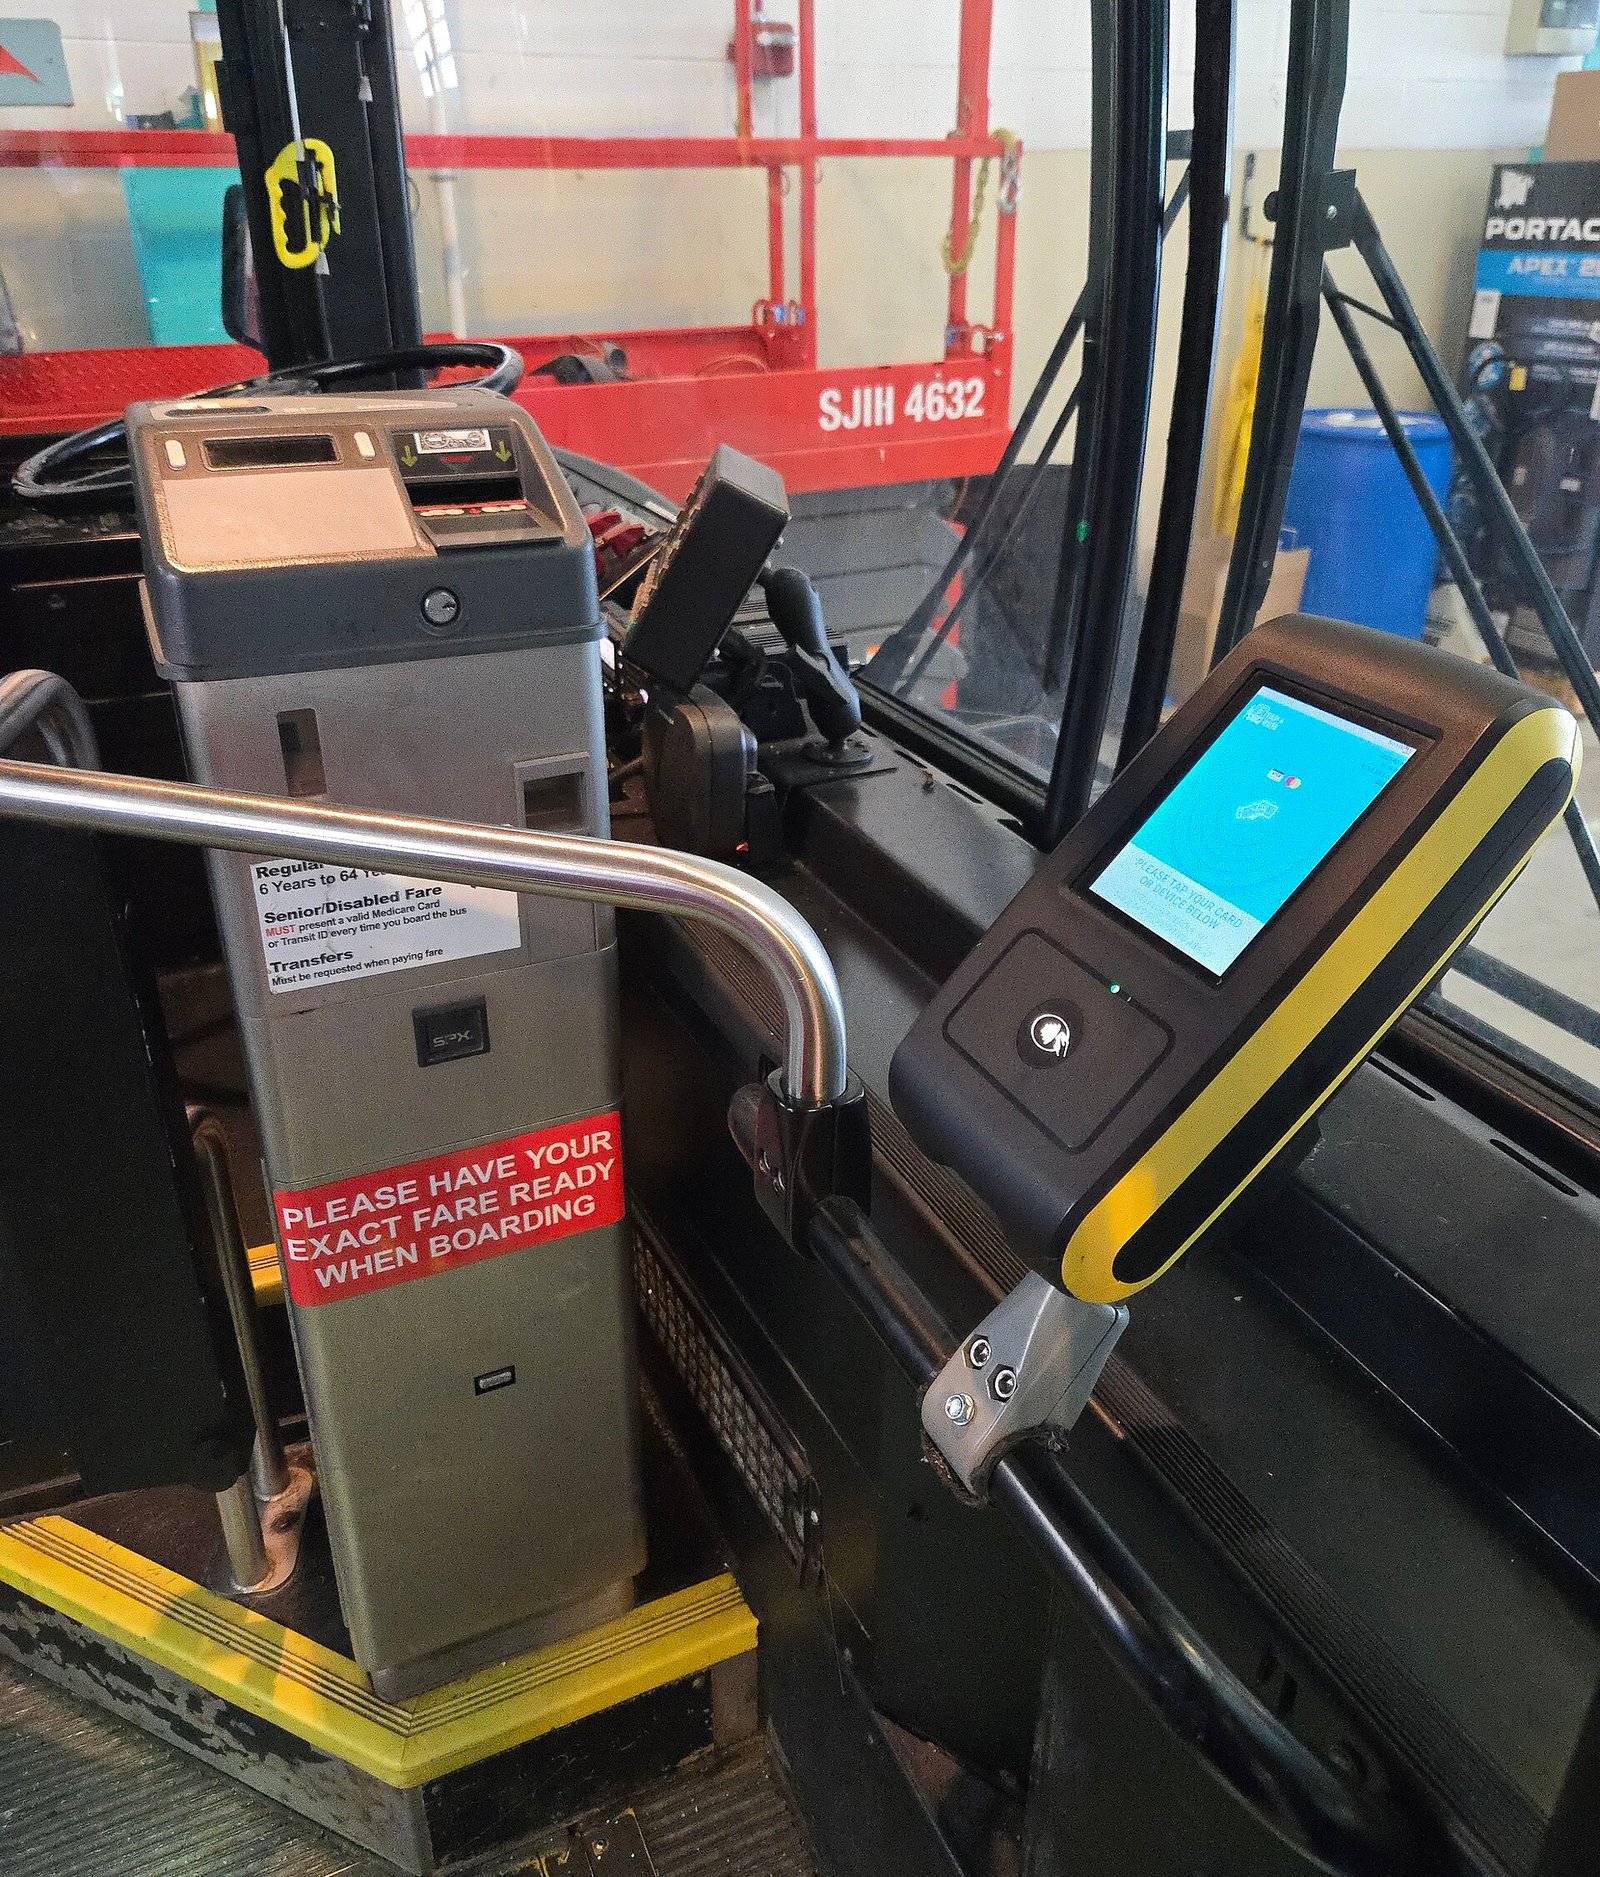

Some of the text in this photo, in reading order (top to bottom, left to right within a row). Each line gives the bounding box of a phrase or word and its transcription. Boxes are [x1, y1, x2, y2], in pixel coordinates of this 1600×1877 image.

[819, 377, 985, 431] SJIH 4632
[260, 883, 268, 894] 6
[272, 878, 316, 892] Years
[320, 874, 335, 885] to
[340, 869, 358, 882] 64
[264, 886, 442, 923] Senior/Disabled Fare
[1135, 858, 1171, 882] PLEASE
[1169, 878, 1189, 894] TAP
[1188, 890, 1216, 913] YOUR
[1214, 907, 1243, 928] CARD
[1140, 875, 1154, 889] OR
[1152, 883, 1187, 910] DEVICE
[1185, 904, 1219, 930] BELOW
[265, 924, 296, 937] MUST
[299, 917, 336, 933] present
[346, 912, 370, 922] valid
[372, 905, 415, 918] Medicare
[417, 900, 440, 911] Card
[268, 906, 467, 948] or Transit ID every time you board the bus
[270, 950, 354, 974] Transfers
[272, 948, 444, 987] Must be requested when paying fare
[283, 1131, 612, 1230] PLEASE HAVE YOUR
[287, 1158, 616, 1262] EXACT FARE READY
[315, 1195, 596, 1288] WHEN BOARDING
